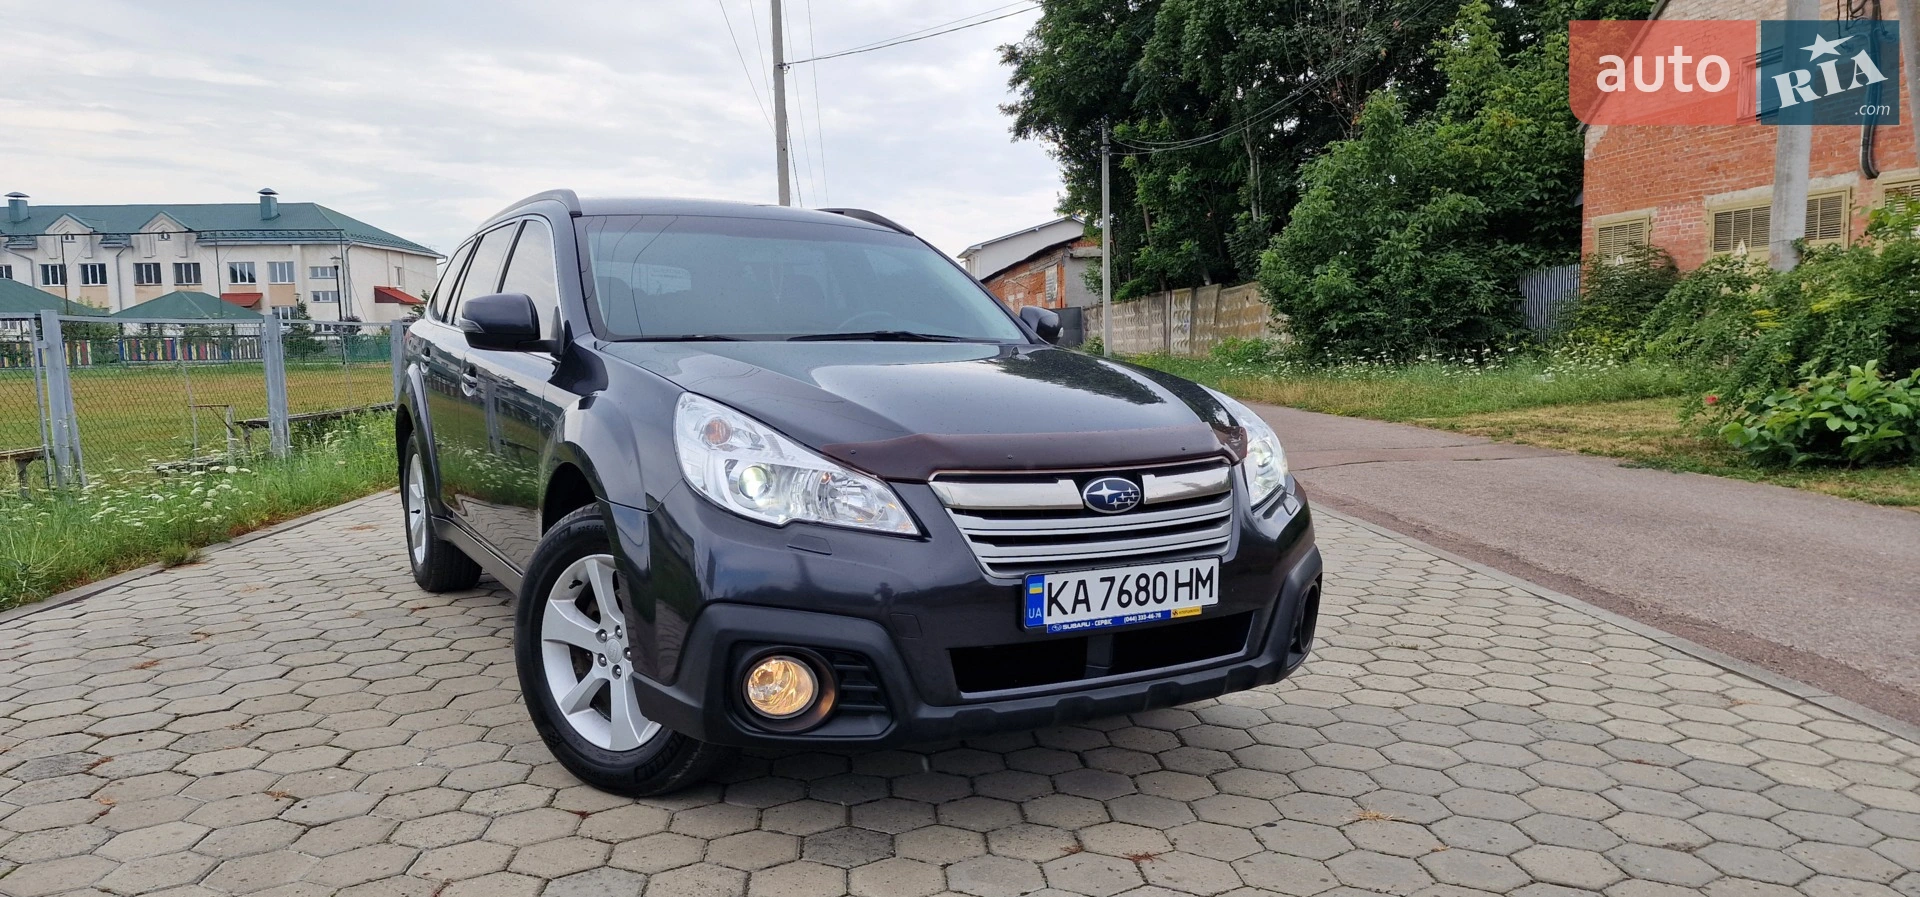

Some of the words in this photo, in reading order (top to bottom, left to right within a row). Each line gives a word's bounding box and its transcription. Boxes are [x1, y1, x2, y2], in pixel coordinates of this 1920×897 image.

[1046, 579, 1092, 617] KA
[1099, 570, 1168, 611] 7680
[1174, 565, 1214, 603] HM
[1028, 607, 1043, 619] UA
[1062, 621, 1091, 630] SUBARU
